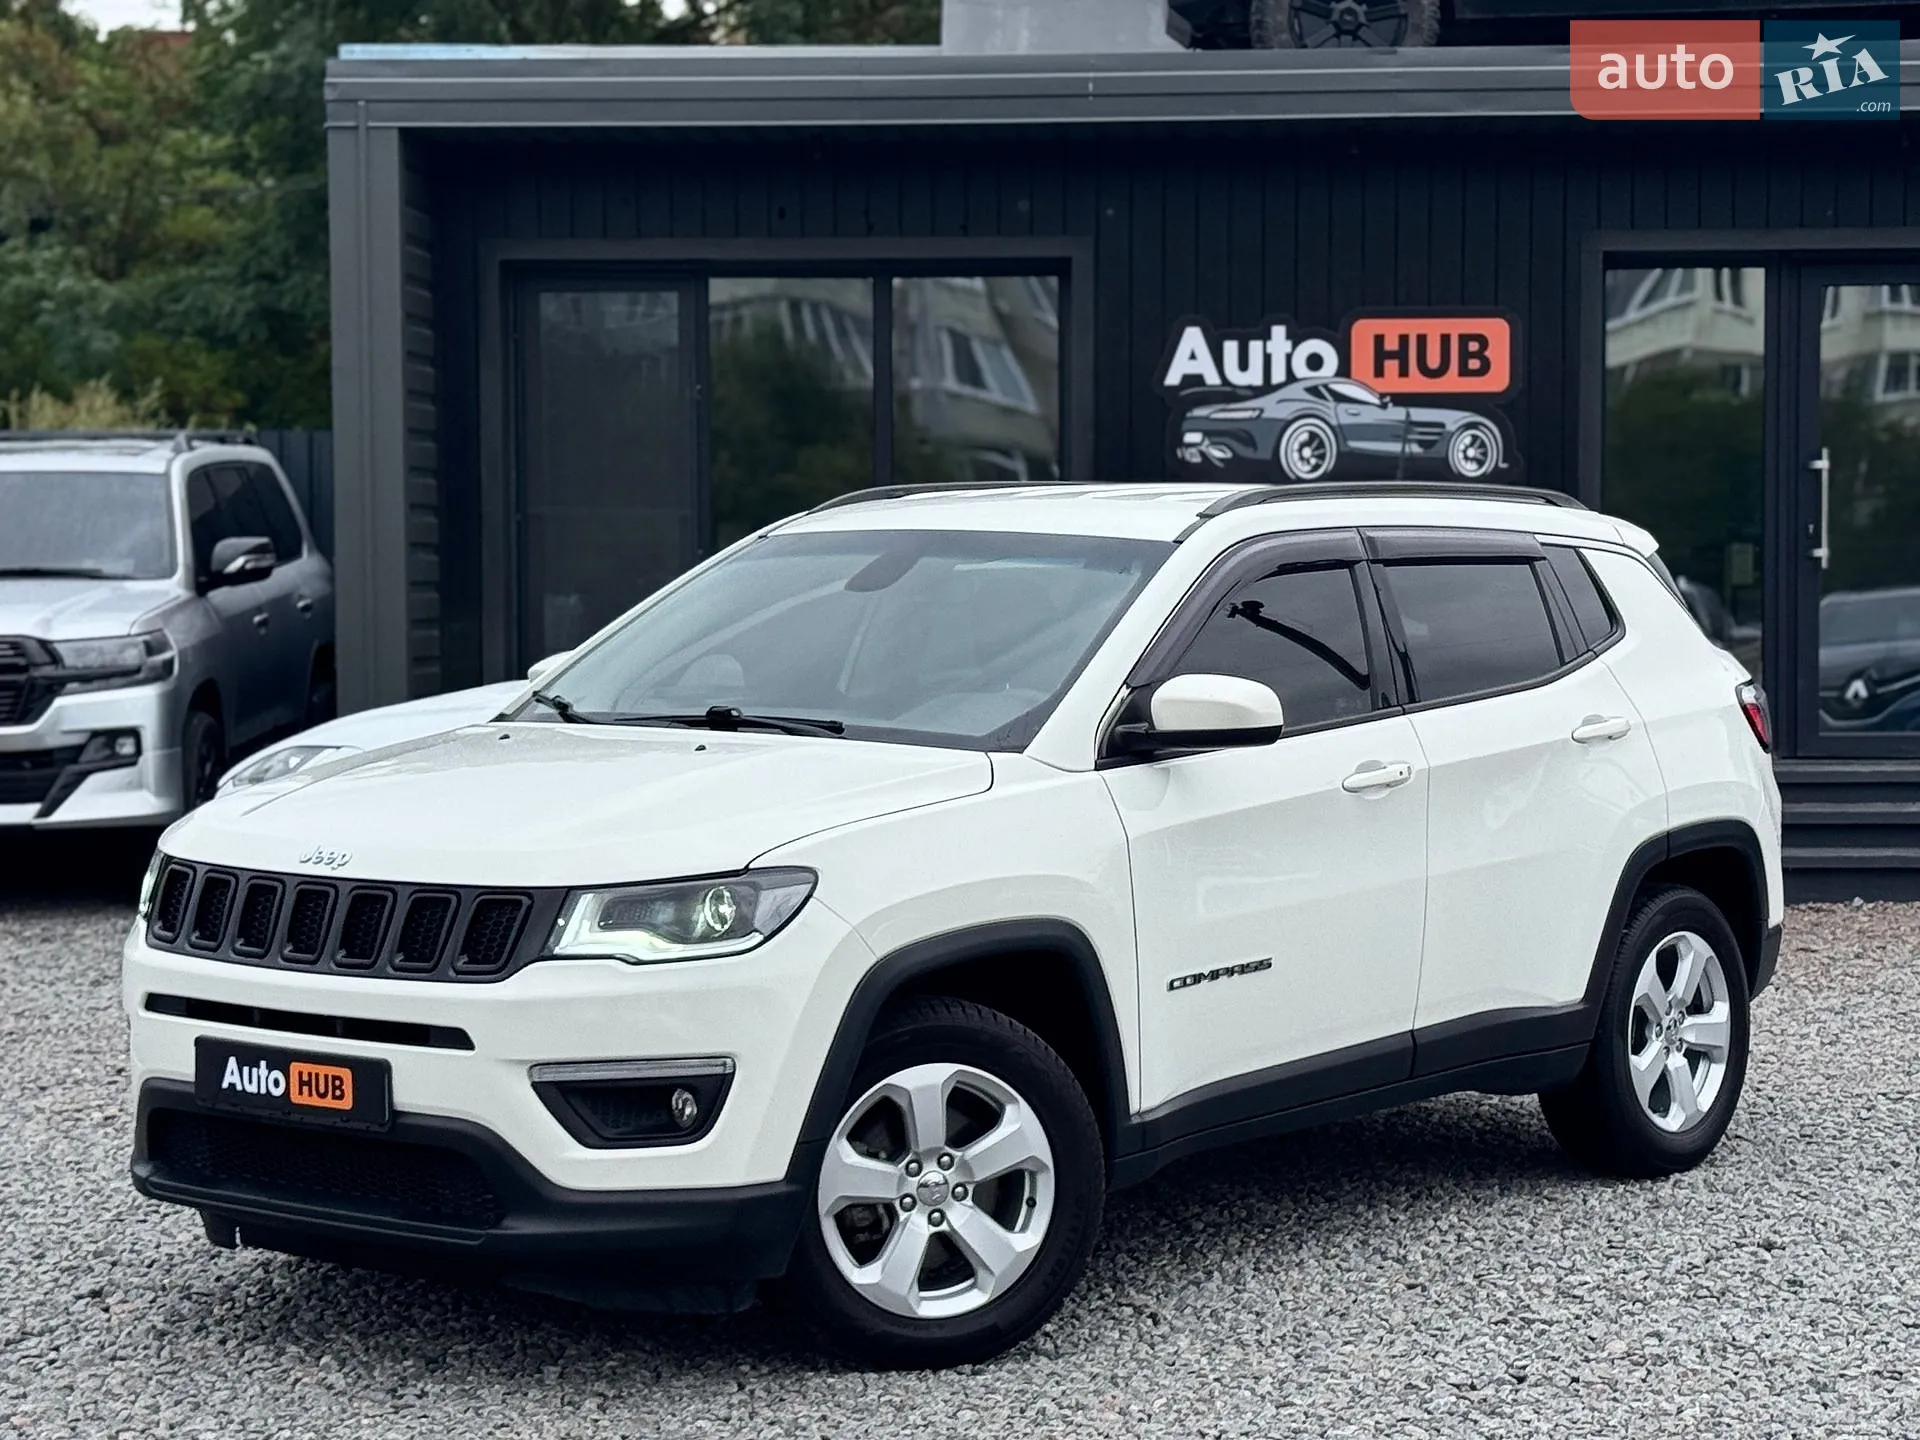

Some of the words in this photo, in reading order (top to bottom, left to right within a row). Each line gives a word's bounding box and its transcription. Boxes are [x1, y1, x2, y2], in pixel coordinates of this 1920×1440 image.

[1163, 325, 1339, 387] Auto
[1373, 333, 1492, 378] HUB
[298, 844, 353, 871] Jeep
[1166, 957, 1273, 992] COMPASS
[221, 1056, 286, 1097] Auto
[297, 1070, 345, 1101] HUB
